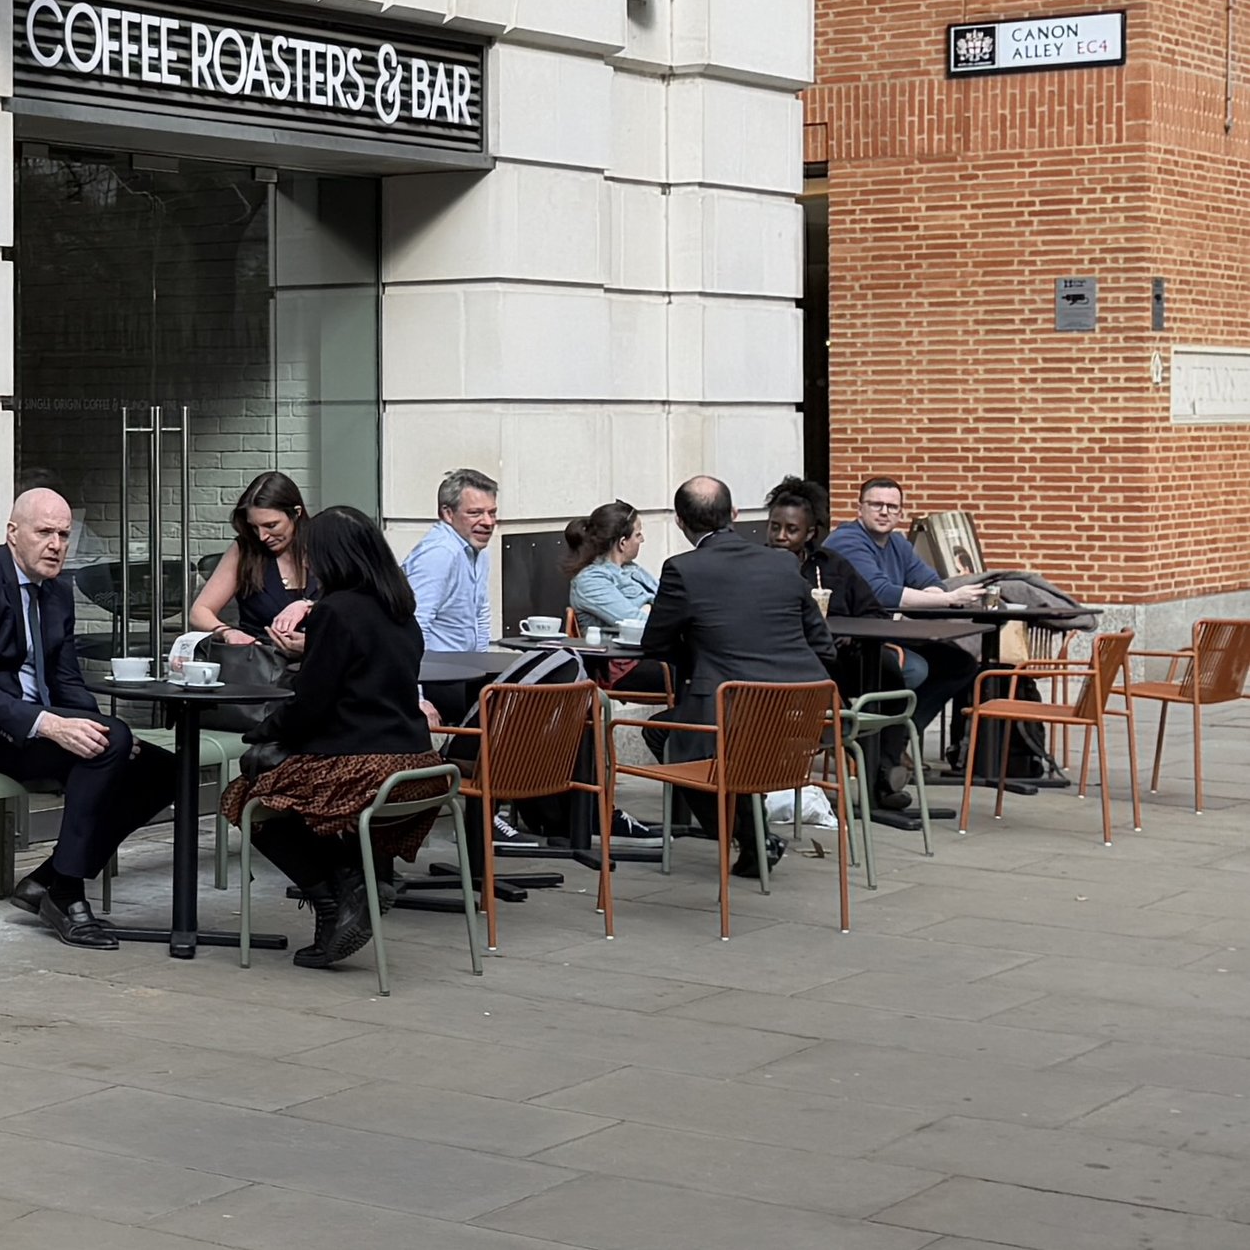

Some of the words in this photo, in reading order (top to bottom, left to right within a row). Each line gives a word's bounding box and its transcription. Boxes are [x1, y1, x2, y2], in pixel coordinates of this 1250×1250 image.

[1011, 23, 1079, 42] CANON
[1012, 42, 1064, 60] ALLEY
[1077, 39, 1108, 55] EC4
[191, 22, 366, 111] ROASTERS
[375, 43, 403, 125] &
[411, 57, 473, 125] BAR
